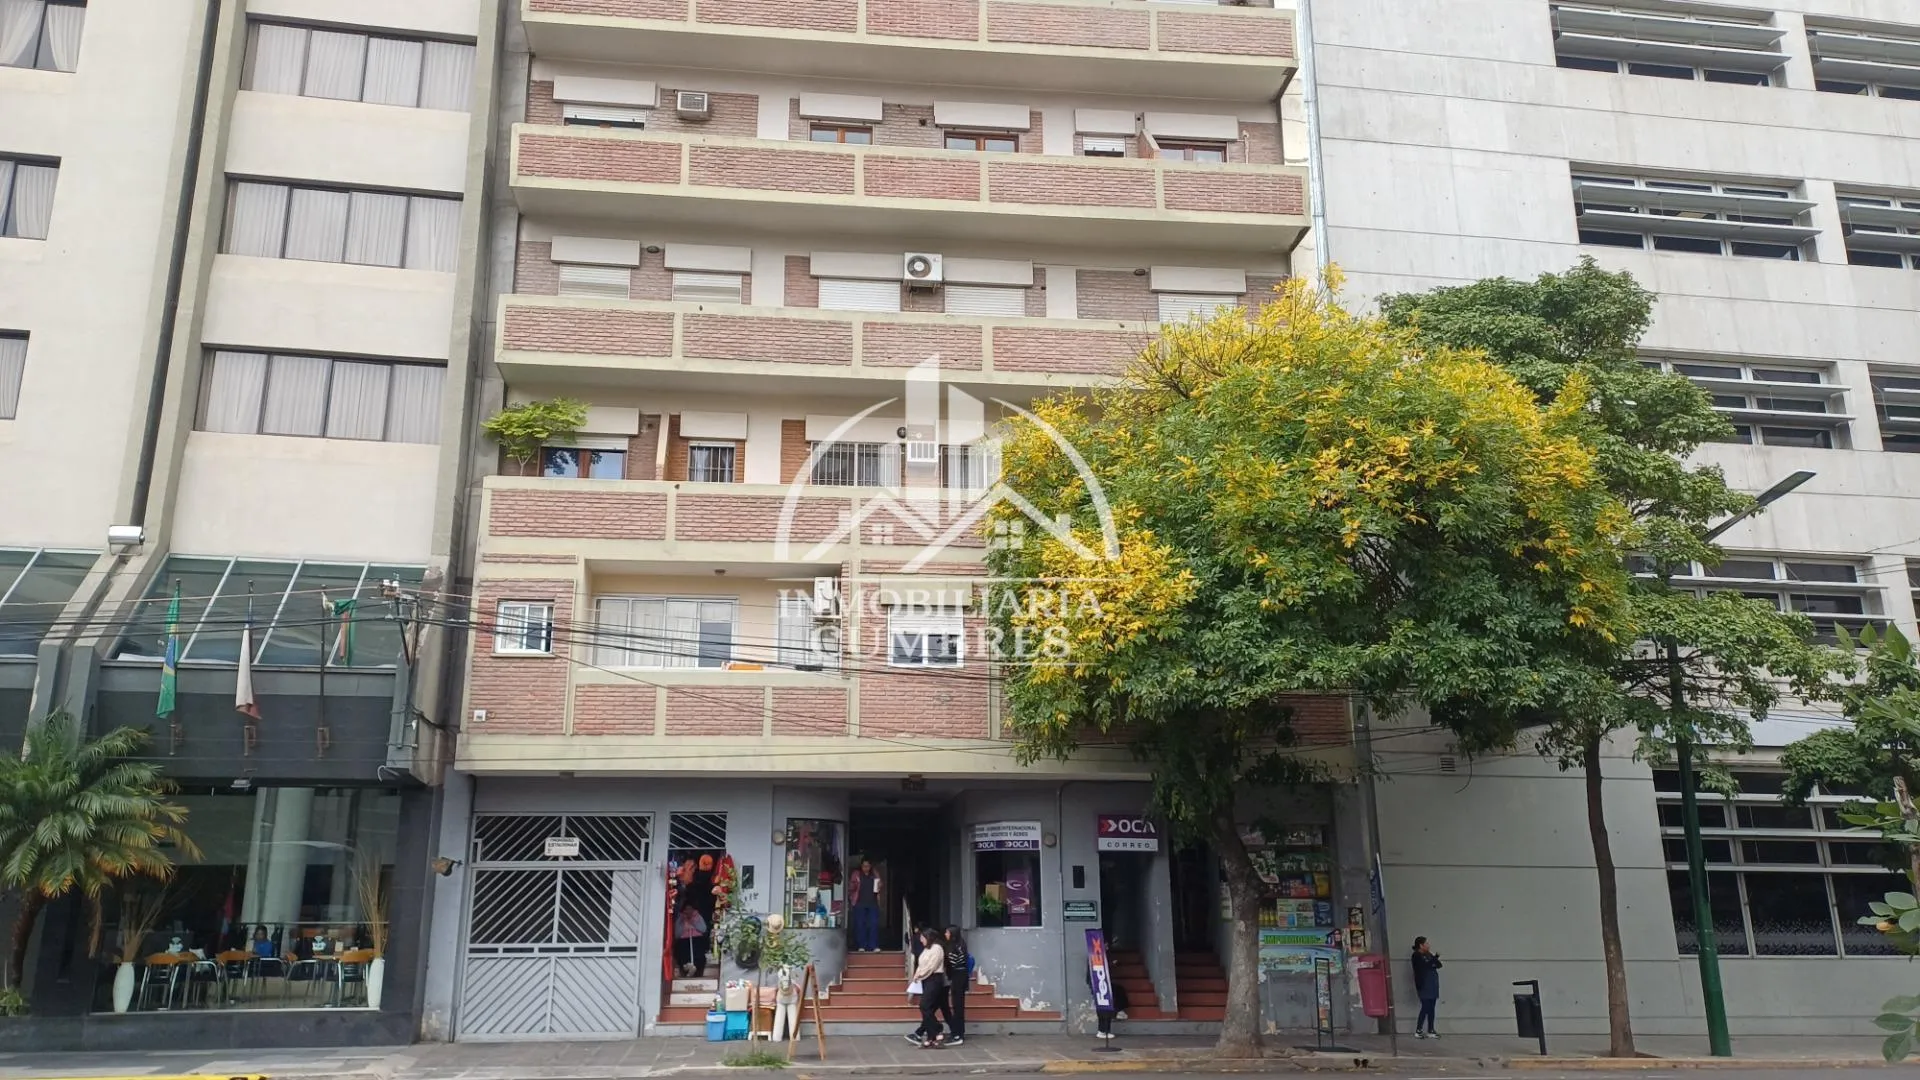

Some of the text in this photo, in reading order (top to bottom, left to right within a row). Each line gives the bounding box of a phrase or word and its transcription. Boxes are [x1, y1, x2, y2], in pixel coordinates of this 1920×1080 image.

[1118, 819, 1156, 833] OCA
[982, 841, 994, 849] OCA
[1091, 937, 1110, 1006] FedEx
